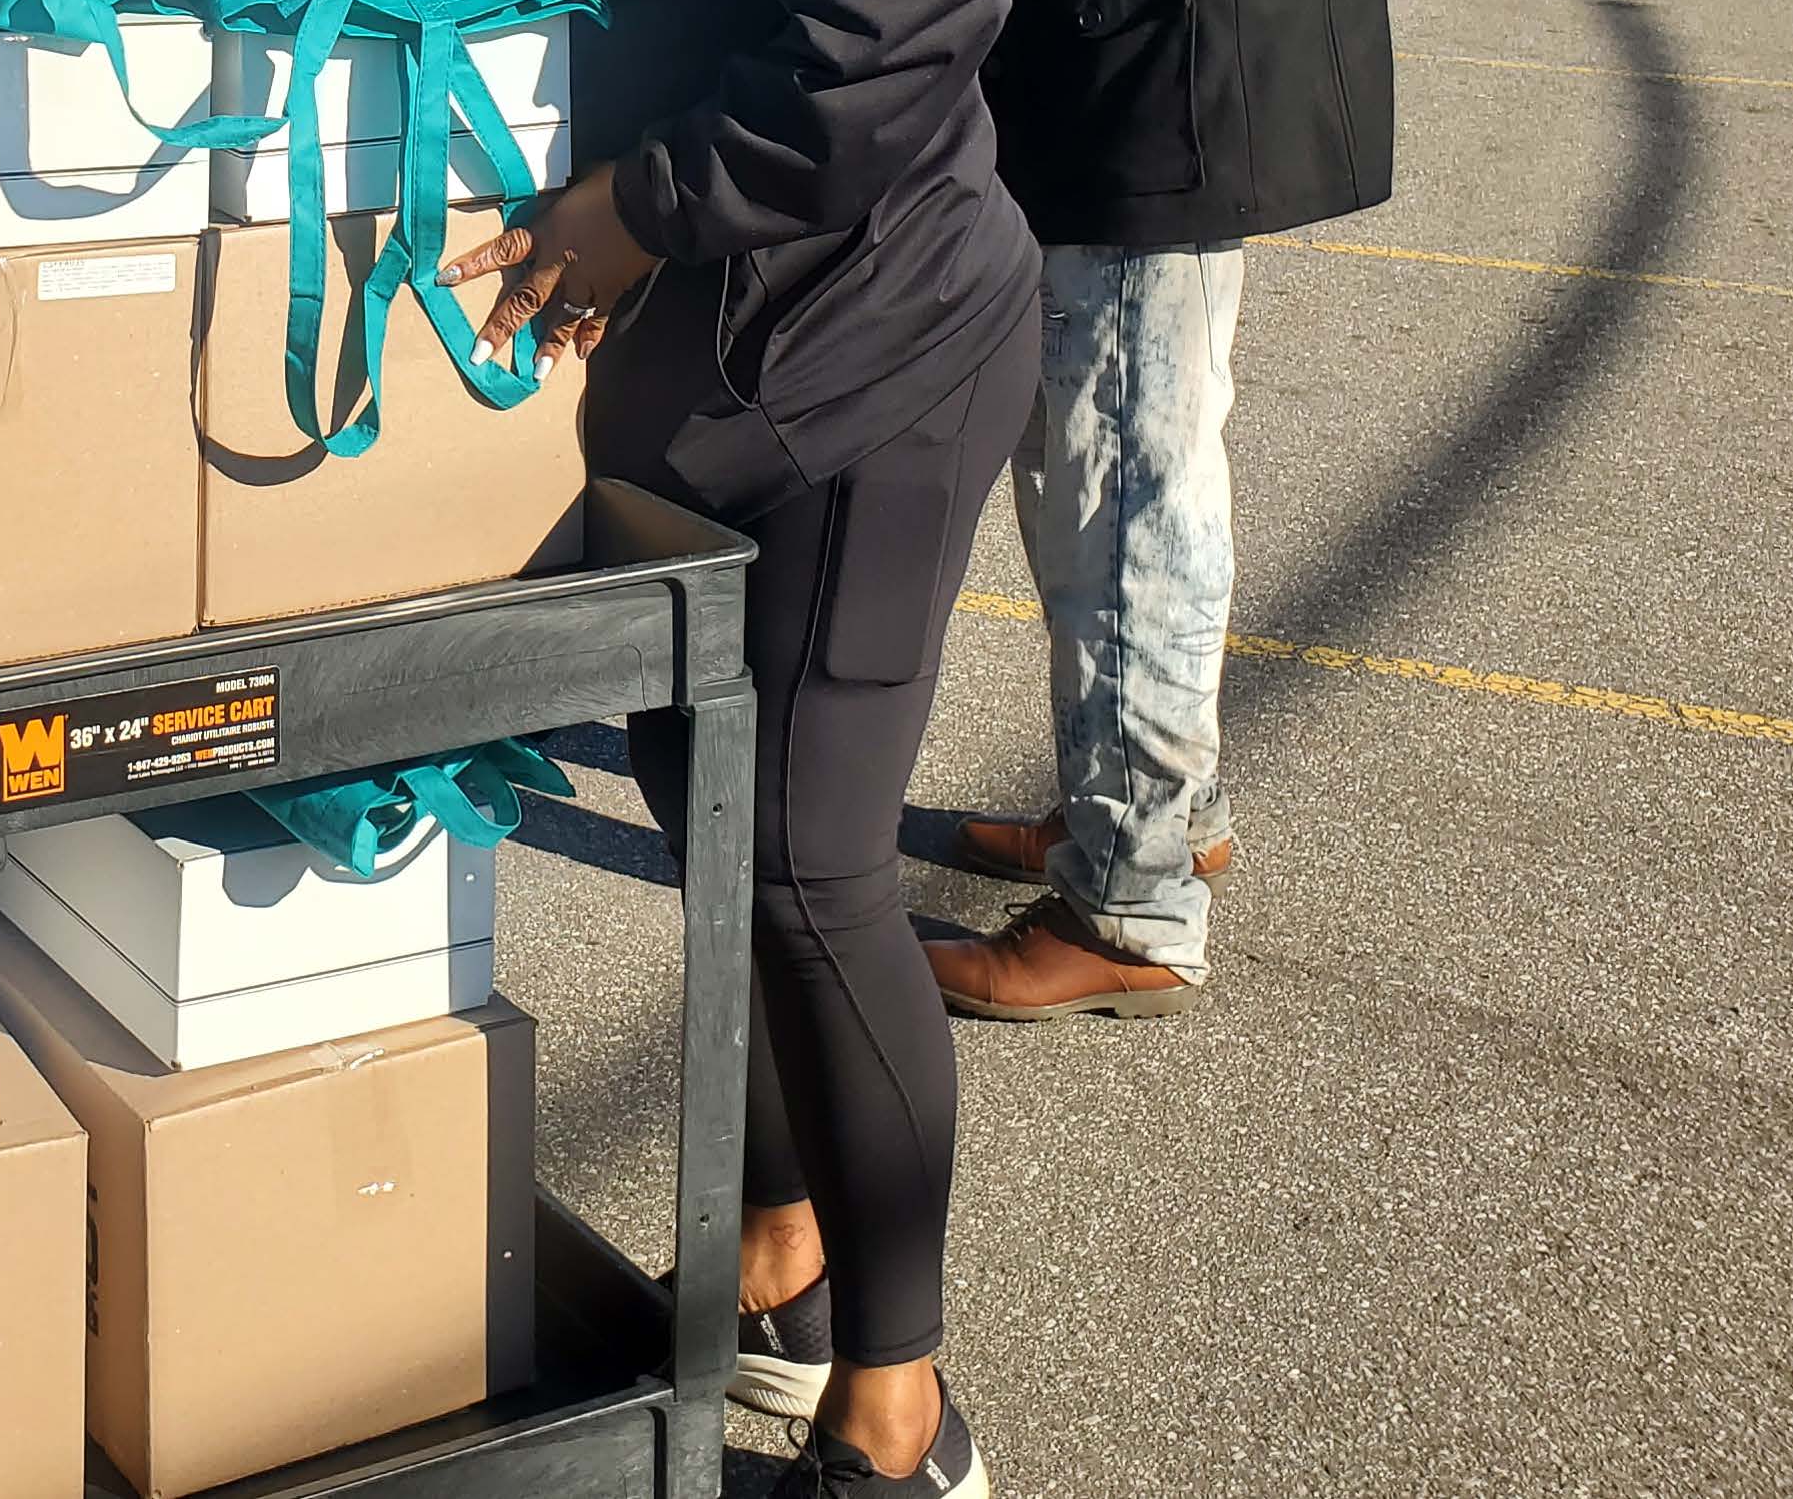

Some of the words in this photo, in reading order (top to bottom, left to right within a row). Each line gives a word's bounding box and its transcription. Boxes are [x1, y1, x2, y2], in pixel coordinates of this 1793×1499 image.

[216, 678, 247, 693] MODEL
[249, 674, 275, 688] 73004
[70, 725, 100, 749] 36"
[119, 717, 149, 741] 24"
[152, 704, 226, 735] SERVICE
[230, 696, 275, 722] CART
[171, 731, 203, 746] CHARIOT
[203, 726, 242, 741] UTILITAIRE
[242, 719, 275, 733] ROBUSTE
[9, 768, 60, 793] WEN
